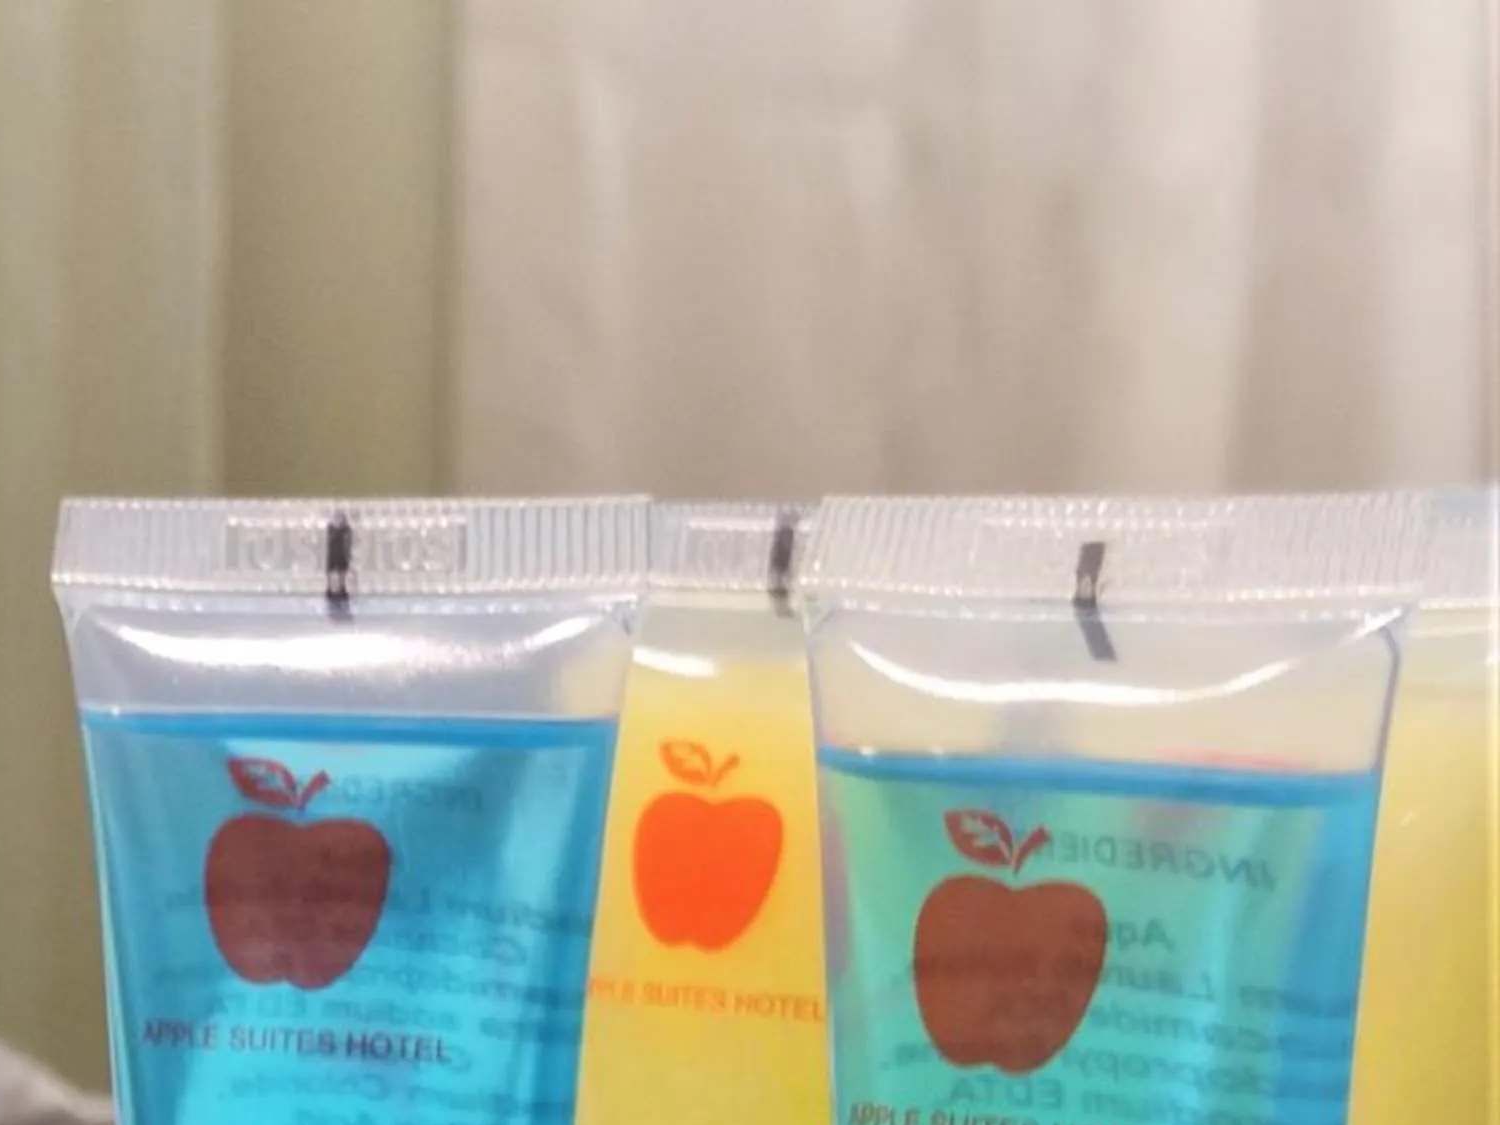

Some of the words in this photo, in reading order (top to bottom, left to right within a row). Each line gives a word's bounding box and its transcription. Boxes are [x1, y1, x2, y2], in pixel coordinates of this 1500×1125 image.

[643, 981, 726, 1012] SUITES
[733, 992, 825, 1022] HOTEL
[143, 1019, 218, 1050] APPLE
[229, 1023, 337, 1057] SUITES
[345, 1029, 452, 1064] HOTEL
